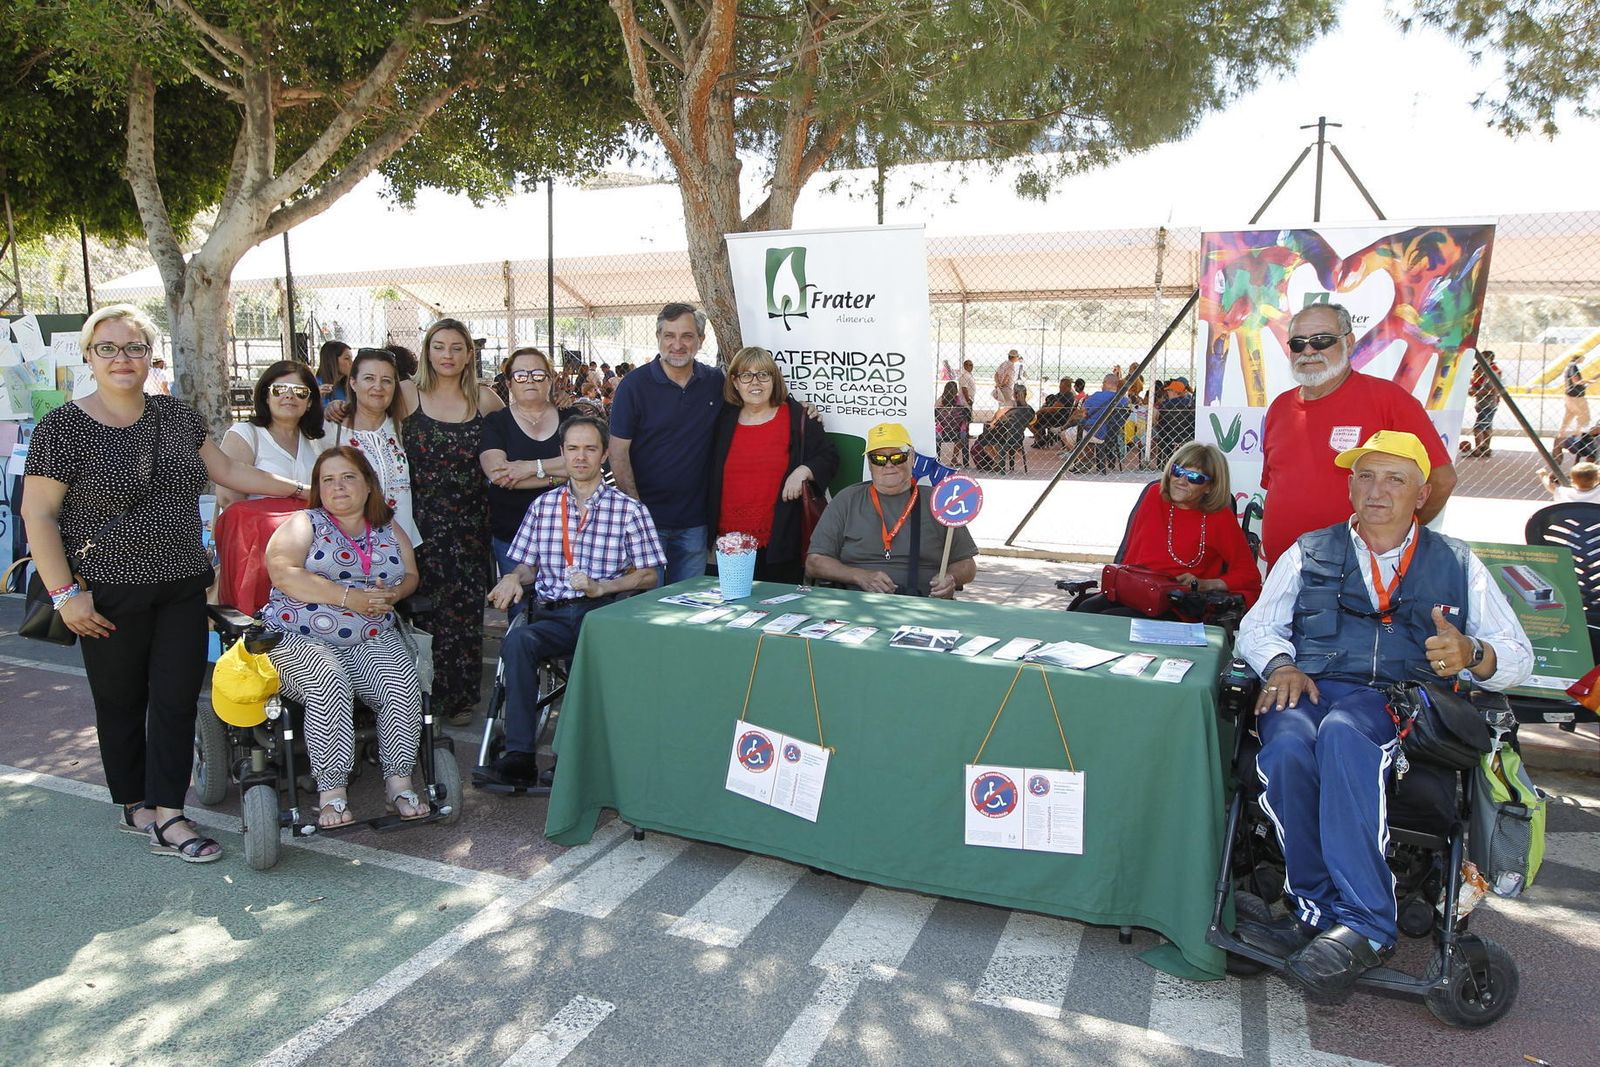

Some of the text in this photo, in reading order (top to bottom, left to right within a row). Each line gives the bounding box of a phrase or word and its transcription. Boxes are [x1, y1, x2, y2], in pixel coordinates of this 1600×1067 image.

[811, 291, 876, 309] Frater
[1351, 314, 1370, 324] ter
[766, 349, 906, 367] ATERNIDAD
[779, 366, 905, 383] LIDARIDAD
[815, 381, 834, 391] DE
[839, 382, 907, 394] CAMBIO
[805, 392, 907, 407] INCLUSIÓN
[815, 405, 907, 417] DE DERECHOS
